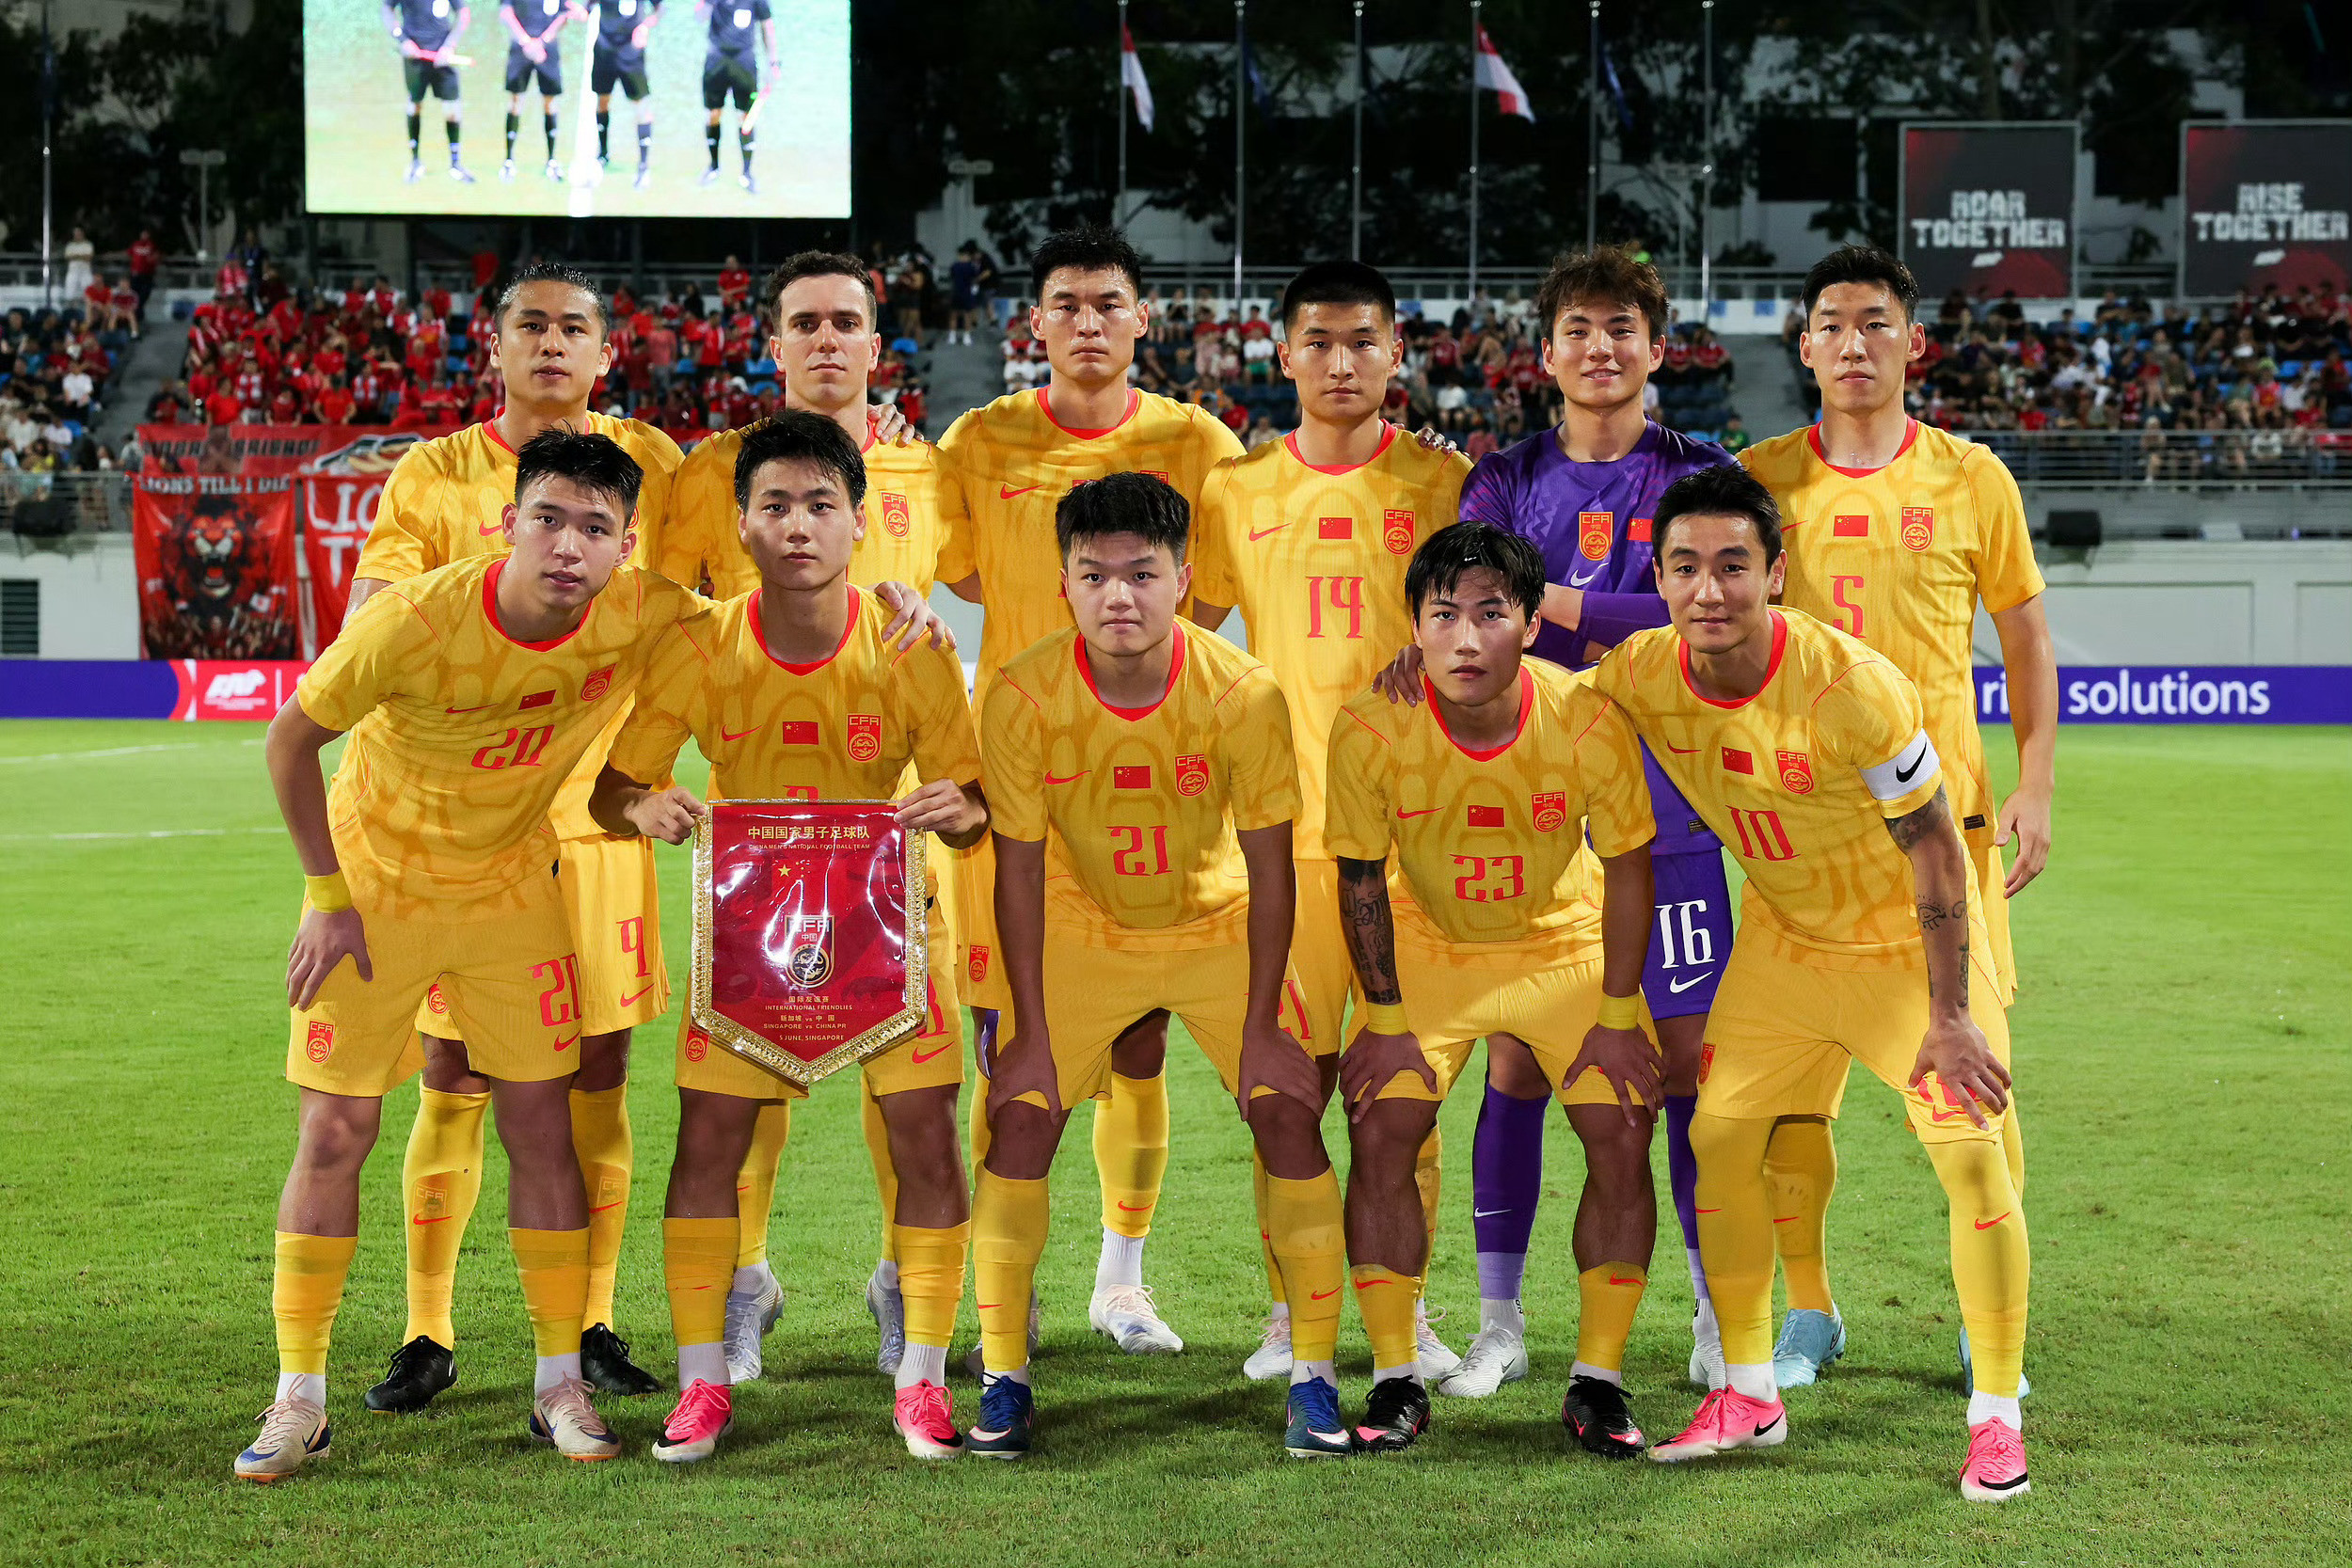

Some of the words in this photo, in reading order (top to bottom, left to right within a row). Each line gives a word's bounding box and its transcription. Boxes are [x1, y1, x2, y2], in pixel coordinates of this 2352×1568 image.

[1950, 190, 2026, 219] ROAR
[2237, 182, 2304, 213] RISE
[1910, 218, 2066, 248] TOGETHER
[2192, 212, 2350, 241] TOGETHER
[139, 475, 194, 494] LIONS
[199, 477, 243, 495] TILL
[246, 477, 253, 494] I
[258, 473, 292, 493] DIE
[883, 493, 907, 505] CFA
[1903, 508, 1931, 517] CFA
[1386, 511, 1413, 522] CFA
[1581, 515, 1610, 524] CFA
[1305, 576, 1365, 639] 14
[1829, 575, 1867, 639] 5
[2067, 669, 2271, 715] solutions
[849, 716, 880, 726] CFA
[470, 723, 555, 770] 20
[1777, 752, 1807, 764] CFA
[1534, 793, 1564, 803] CFA
[748, 826, 870, 840] 中国国家男子足球队
[1724, 804, 1802, 862] 10
[1105, 825, 1174, 877] 21
[1448, 853, 1528, 904] 23
[615, 915, 652, 978] 9
[1655, 899, 1716, 969] 16
[970, 945, 988, 955] CFA
[310, 1022, 333, 1034] CFA
[416, 1186, 444, 1202] CFA
